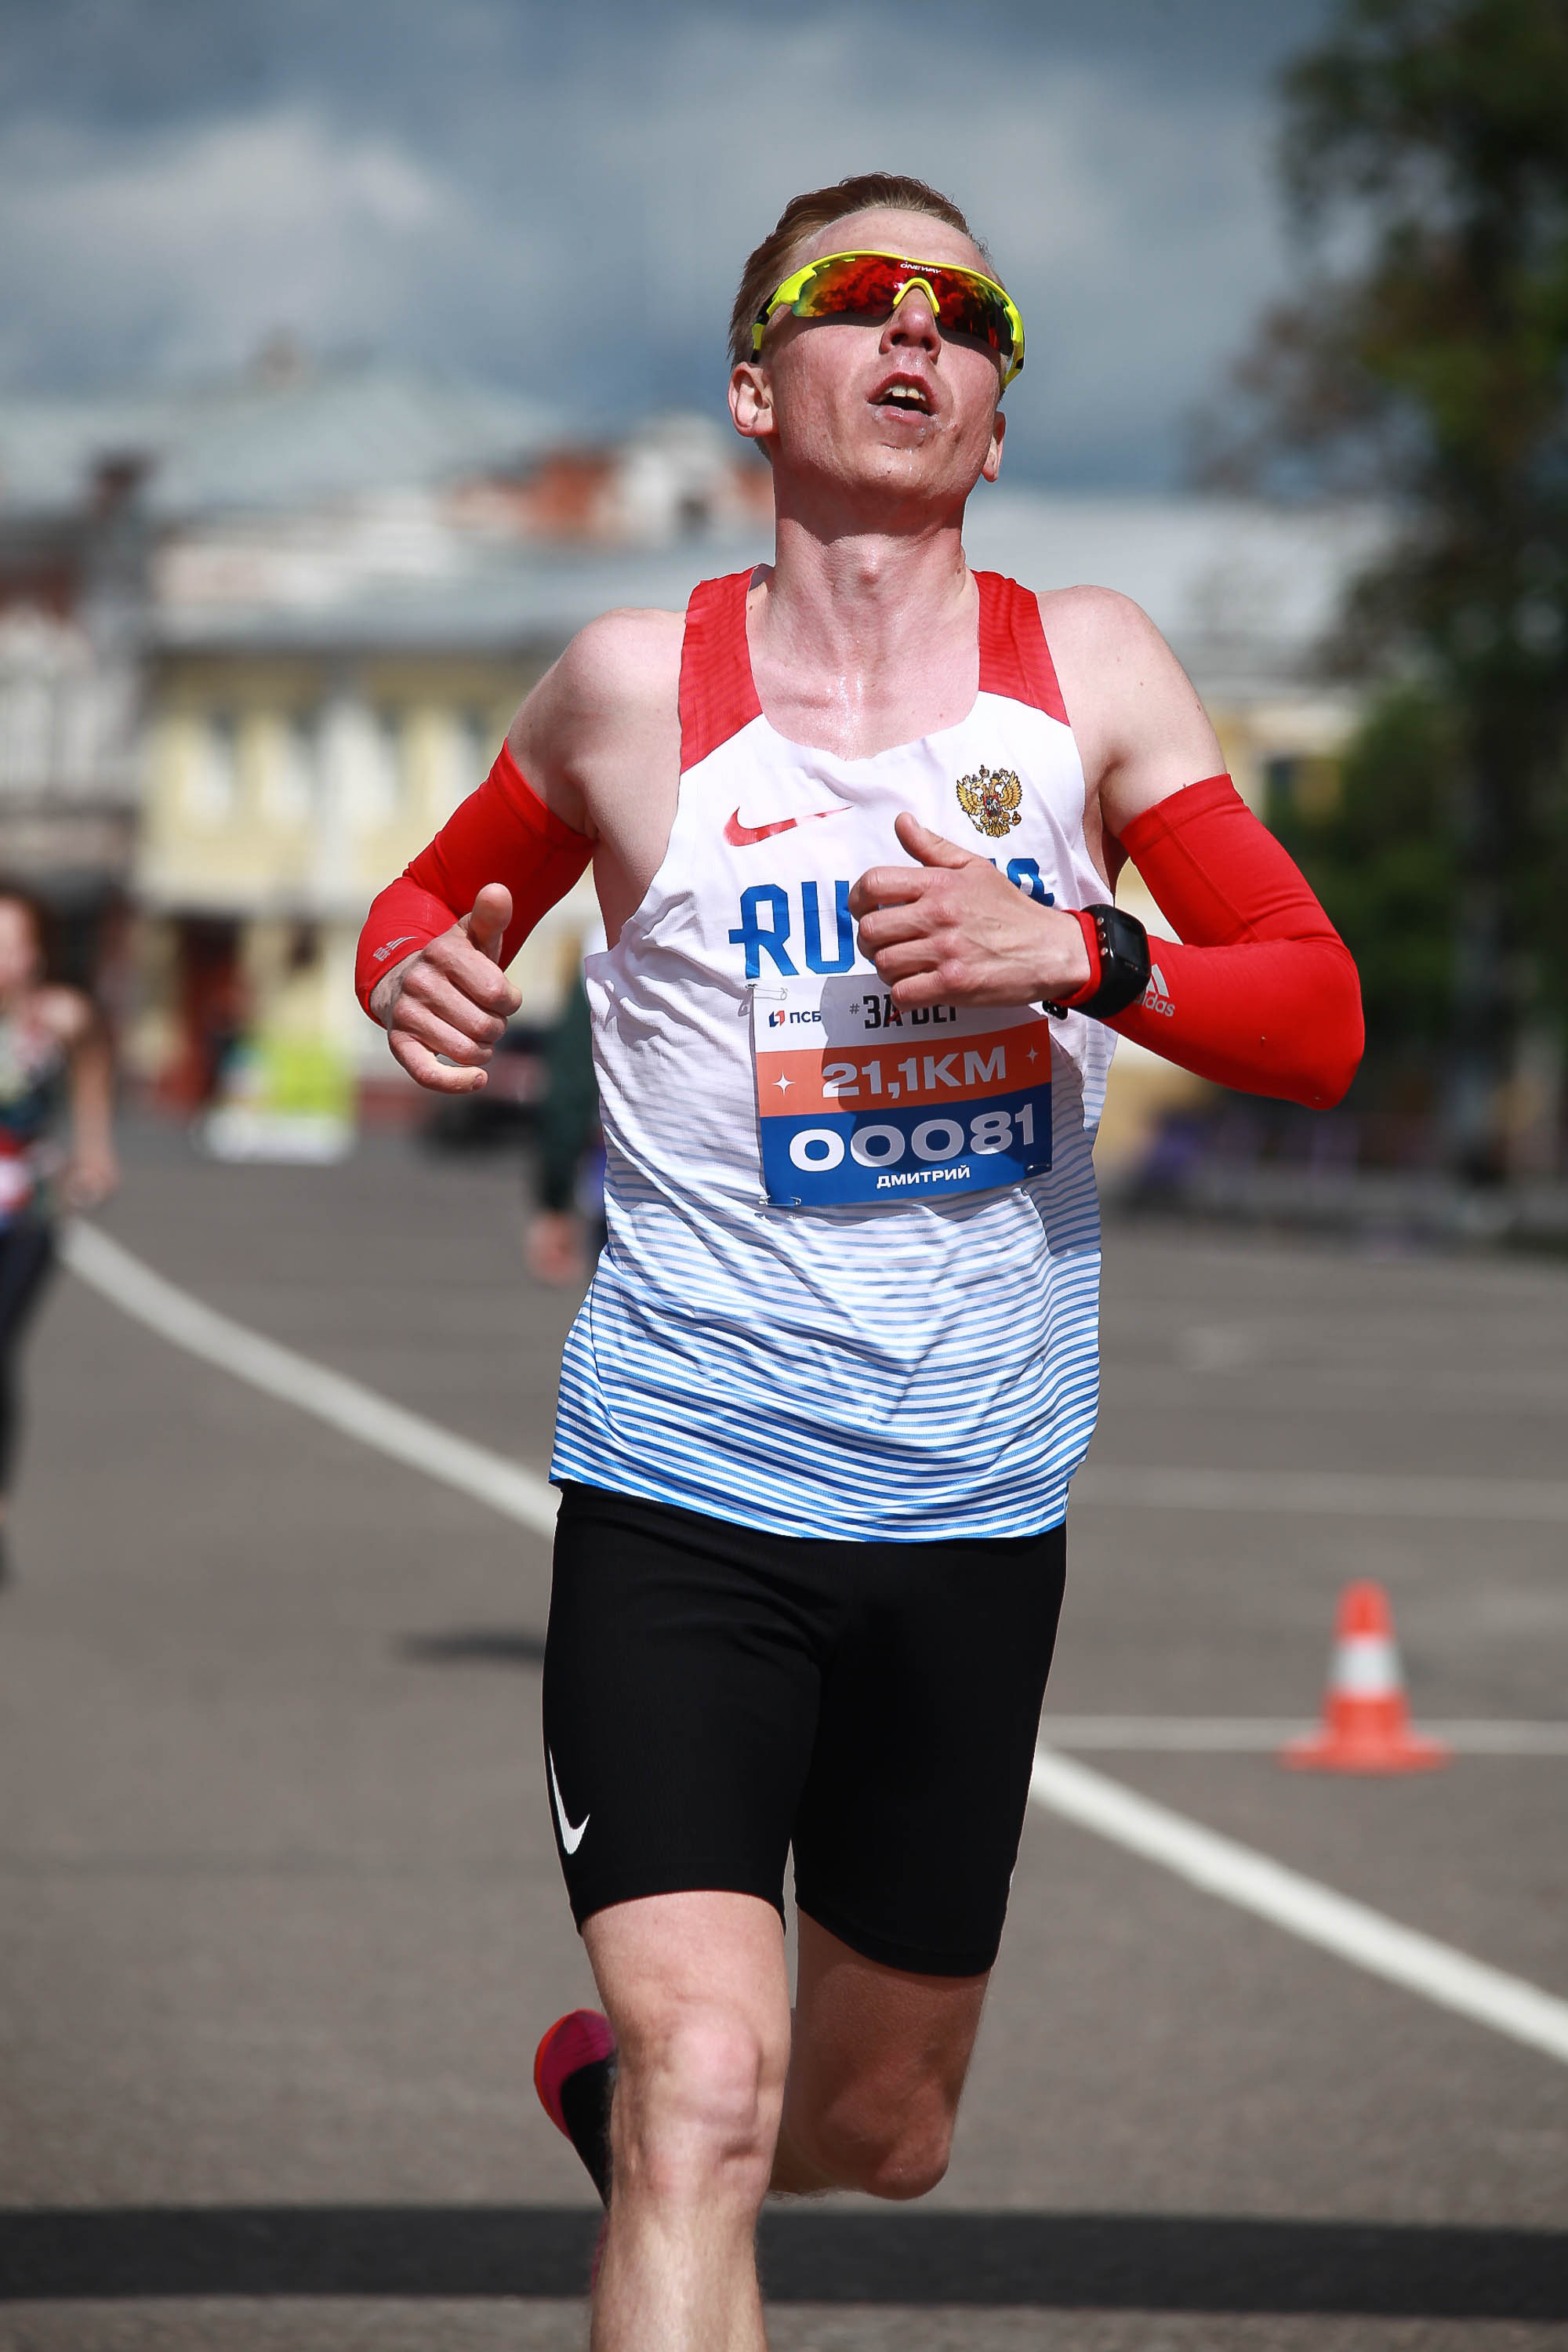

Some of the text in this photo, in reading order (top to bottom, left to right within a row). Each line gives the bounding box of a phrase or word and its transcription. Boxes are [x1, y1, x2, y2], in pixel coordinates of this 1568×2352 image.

[789, 1011, 822, 1024] ПСБ
[822, 1046, 1007, 1099] 21,1КМ
[789, 1103, 1035, 1172] 00081
[876, 1164, 971, 1189] ДМИТРИЙ
